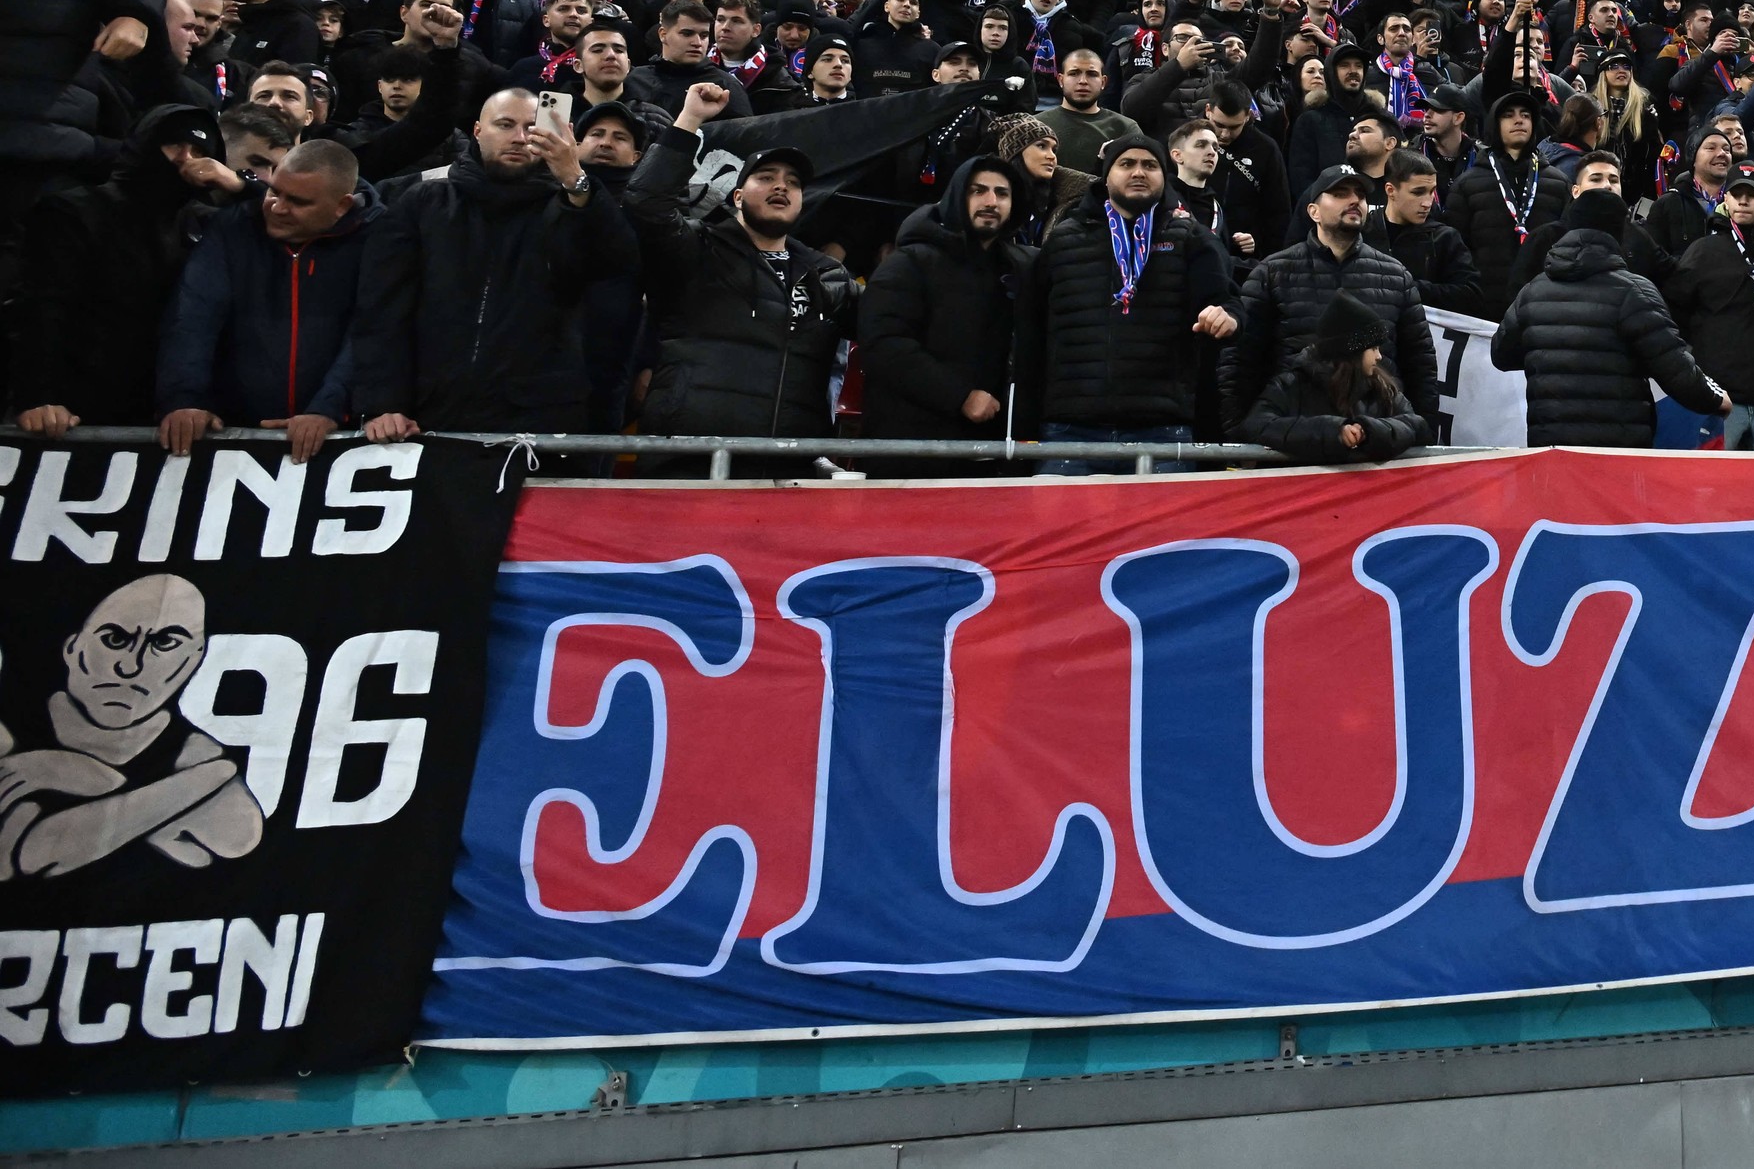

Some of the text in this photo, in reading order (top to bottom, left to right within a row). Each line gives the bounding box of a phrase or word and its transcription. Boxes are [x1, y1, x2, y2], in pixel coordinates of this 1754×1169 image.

[1233, 160, 1255, 182] adidas
[0, 442, 422, 564] KINS
[180, 629, 441, 830] 96
